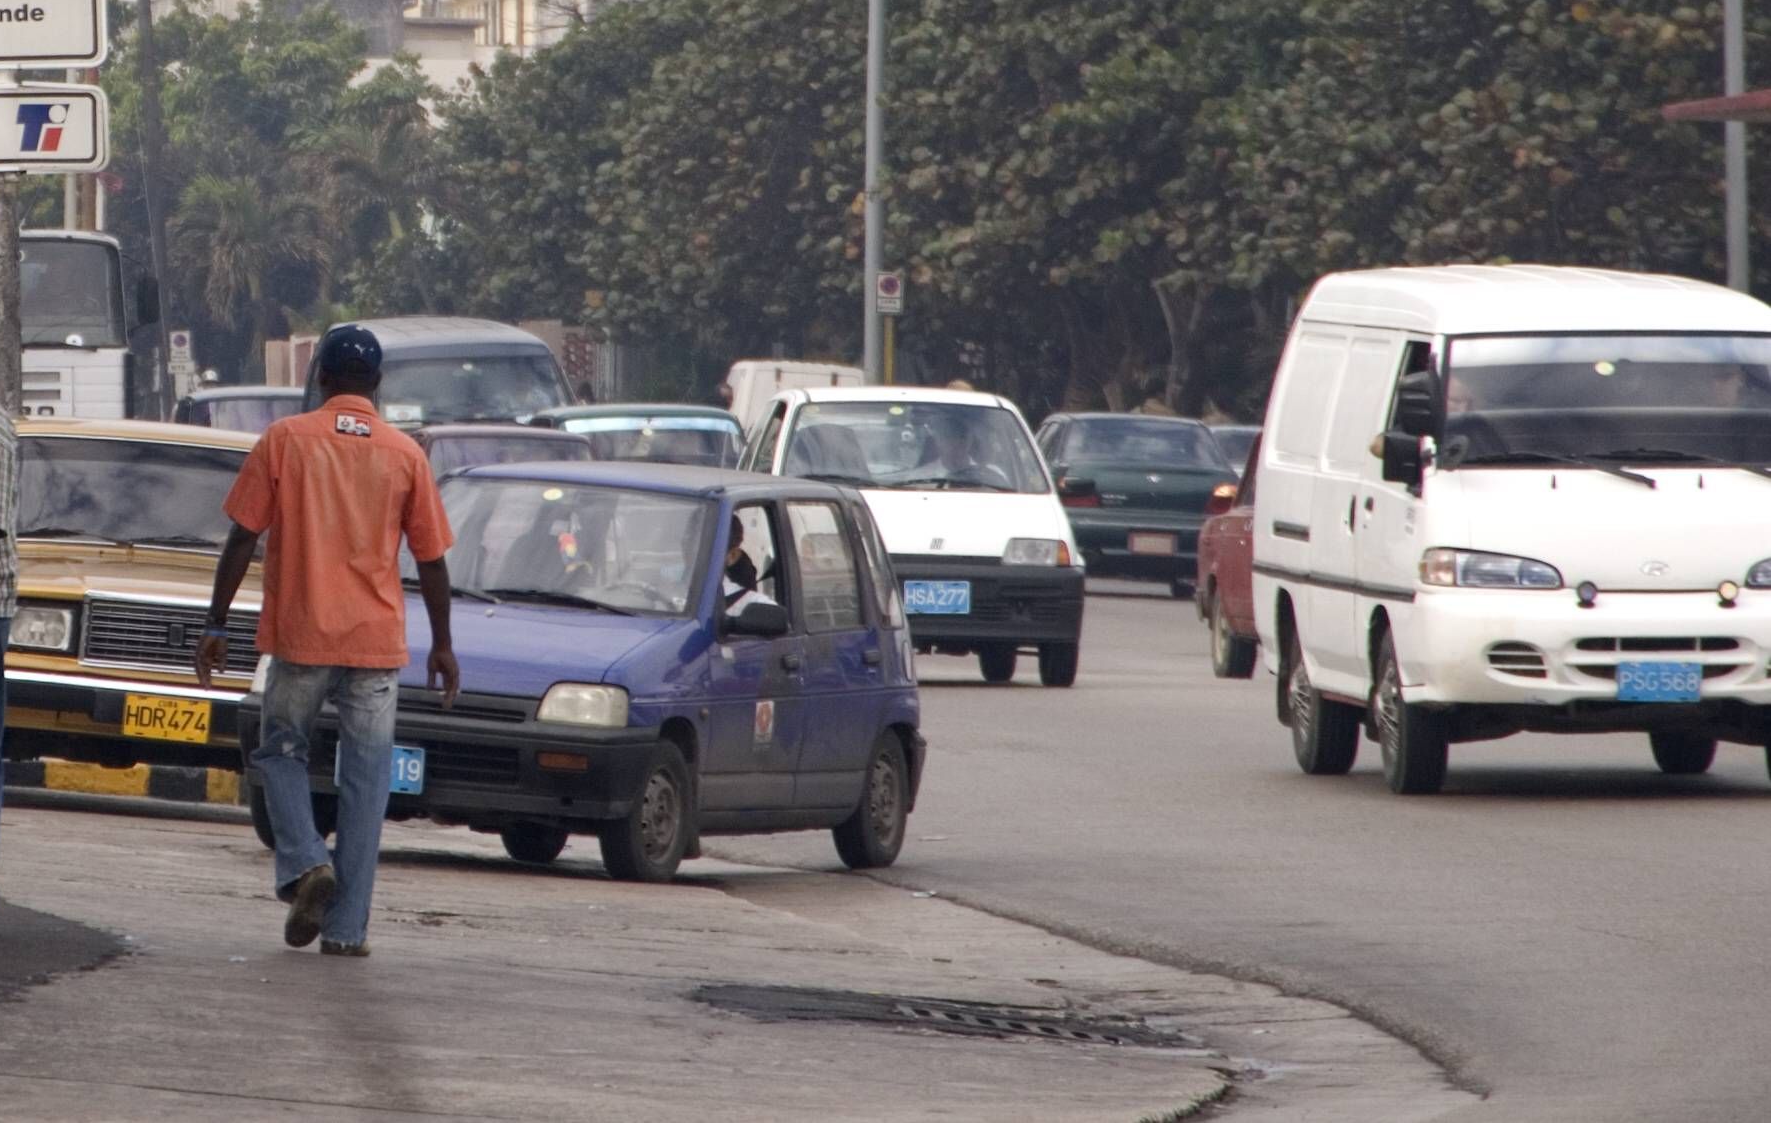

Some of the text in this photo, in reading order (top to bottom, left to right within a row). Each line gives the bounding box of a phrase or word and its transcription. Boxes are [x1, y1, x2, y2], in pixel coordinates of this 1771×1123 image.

[905, 587, 967, 605] HSA277
[1619, 671, 1699, 692] PSG568
[125, 705, 207, 732] HDR474
